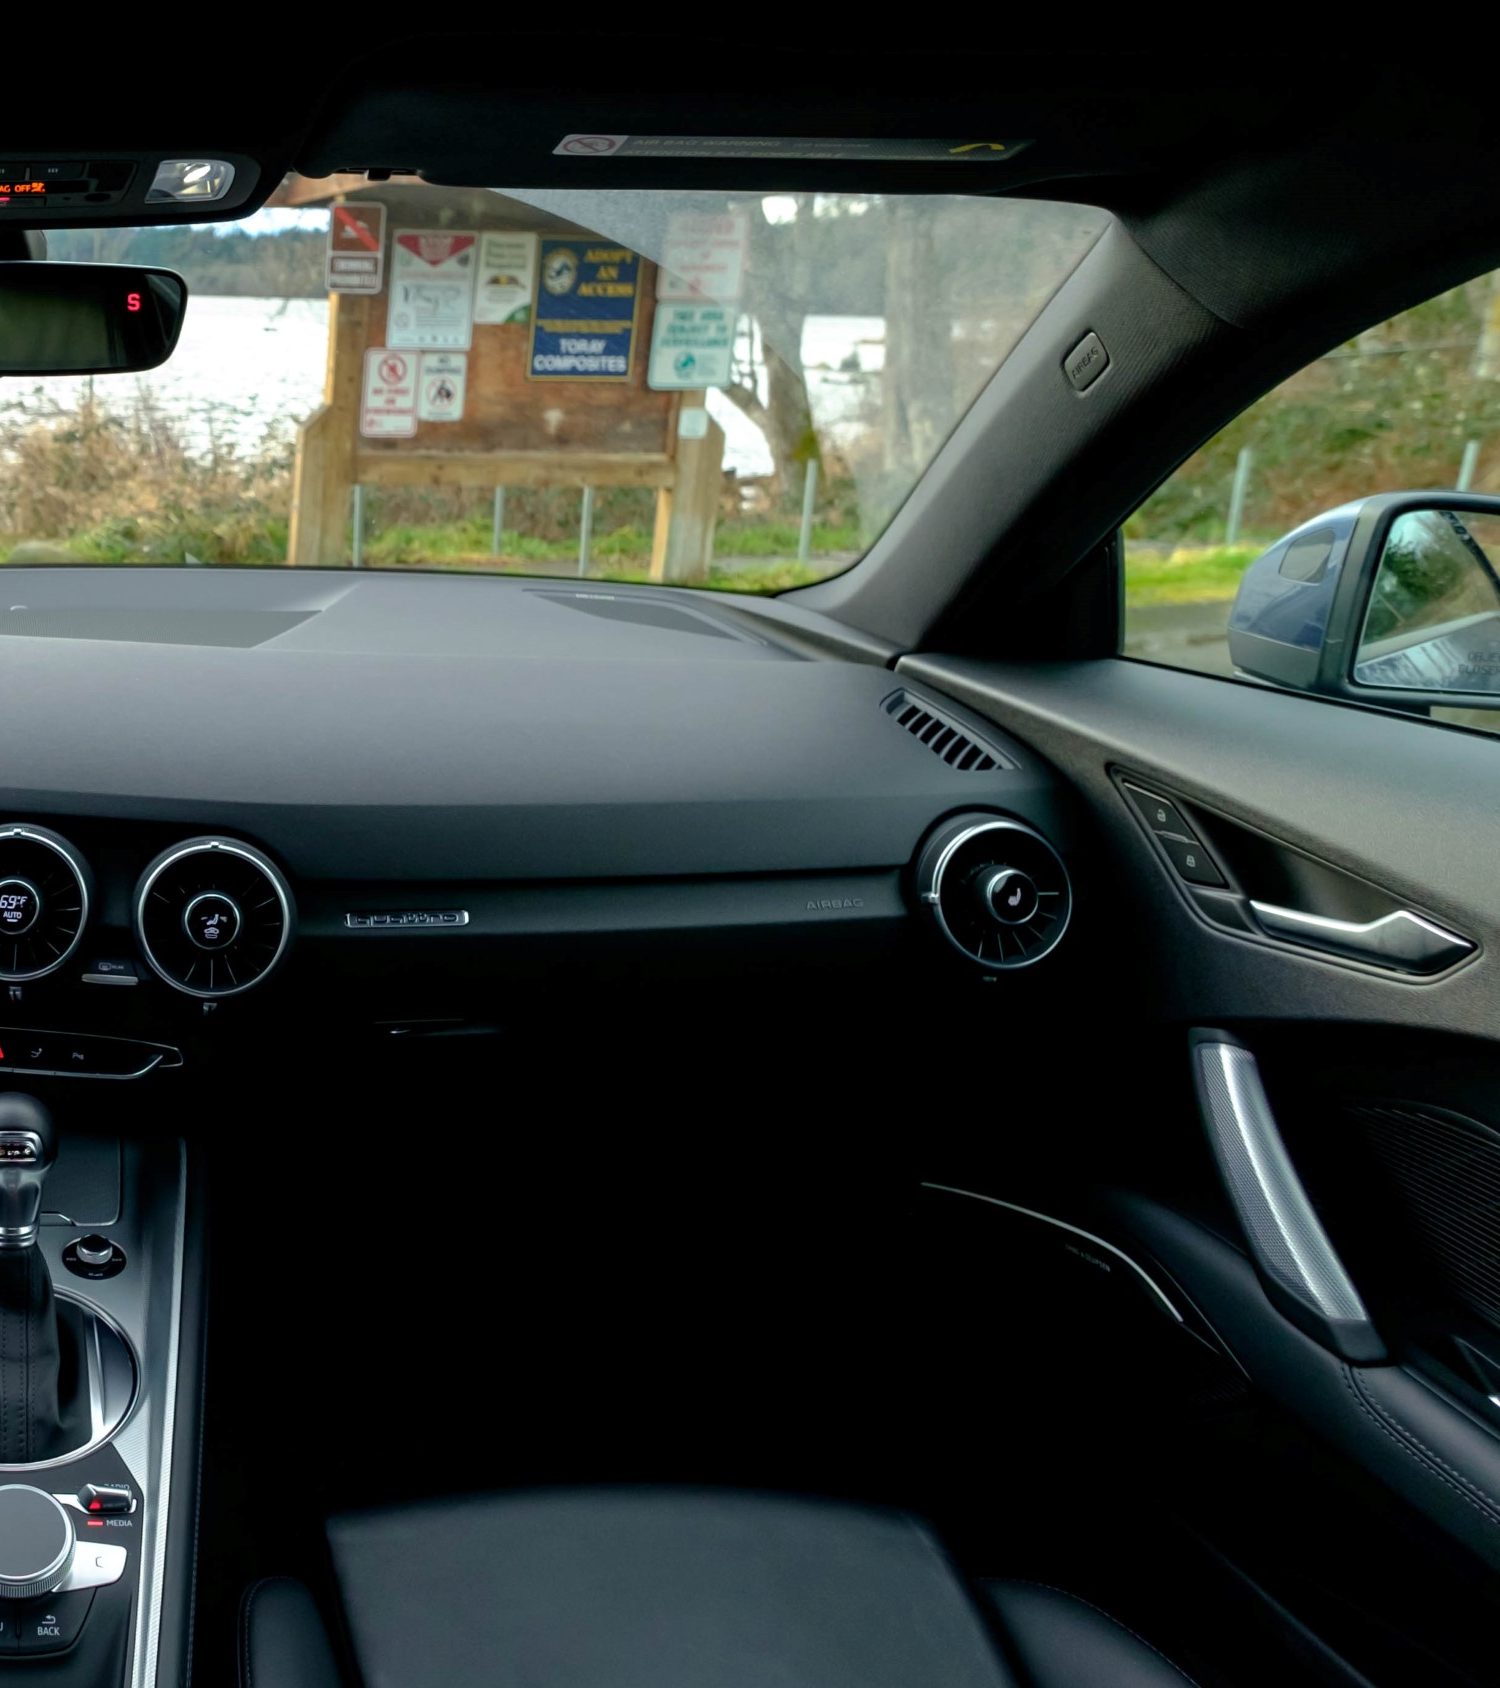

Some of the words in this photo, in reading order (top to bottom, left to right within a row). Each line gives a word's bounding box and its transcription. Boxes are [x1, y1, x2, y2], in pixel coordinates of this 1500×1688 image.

[14, 184, 31, 193] OFF
[596, 265, 620, 280] AN
[128, 293, 140, 311] S
[559, 338, 606, 355] TORAY
[533, 354, 627, 373] COMPOSITES
[806, 898, 864, 911] AIRBAG
[2, 911, 22, 919] AUTO
[356, 913, 459, 926] quattro
[37, 1626, 60, 1636] BACK
